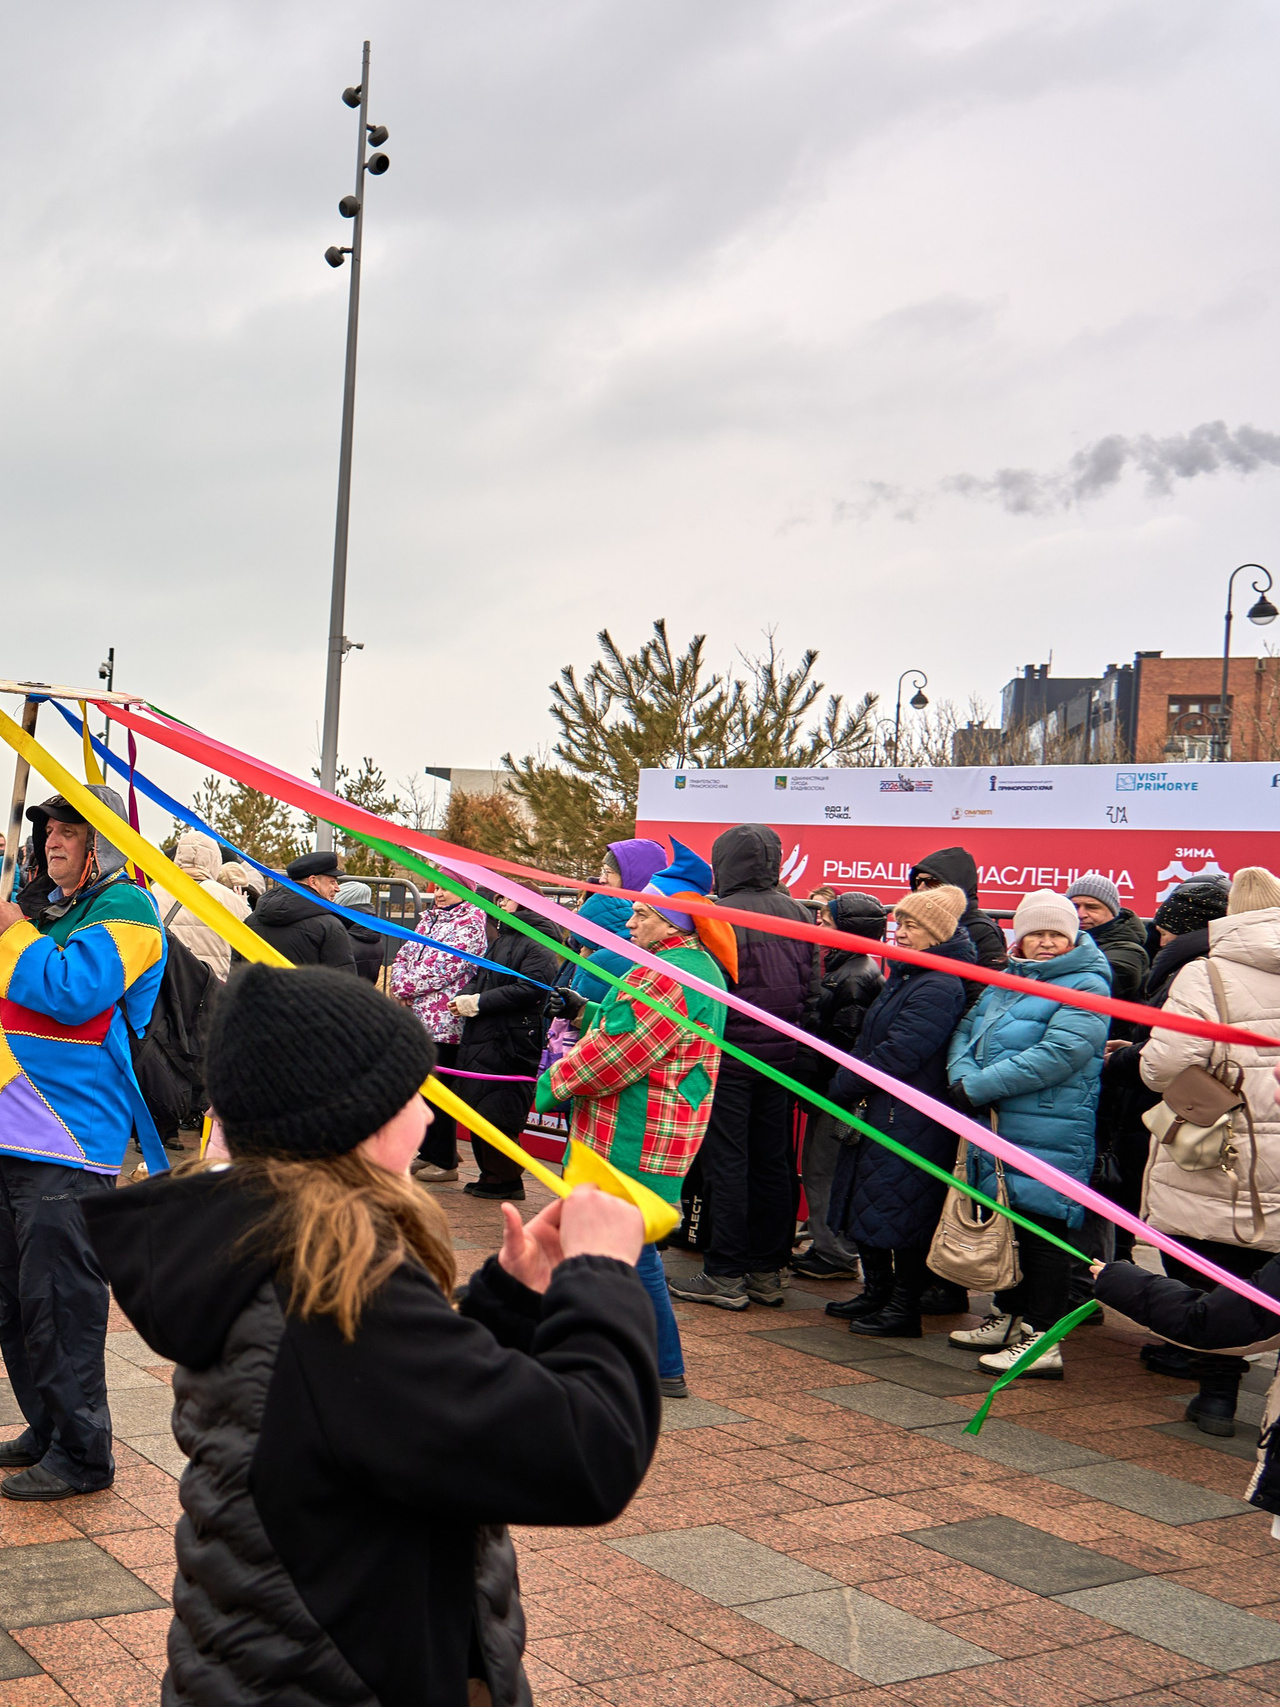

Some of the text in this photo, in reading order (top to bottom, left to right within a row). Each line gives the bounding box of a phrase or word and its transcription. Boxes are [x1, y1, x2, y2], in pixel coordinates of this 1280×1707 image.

[1138, 772, 1168, 781] VISIT
[880, 782, 899, 790] 2026
[1136, 782, 1198, 791] PRIMORYE
[1175, 847, 1215, 858] ЗИМА
